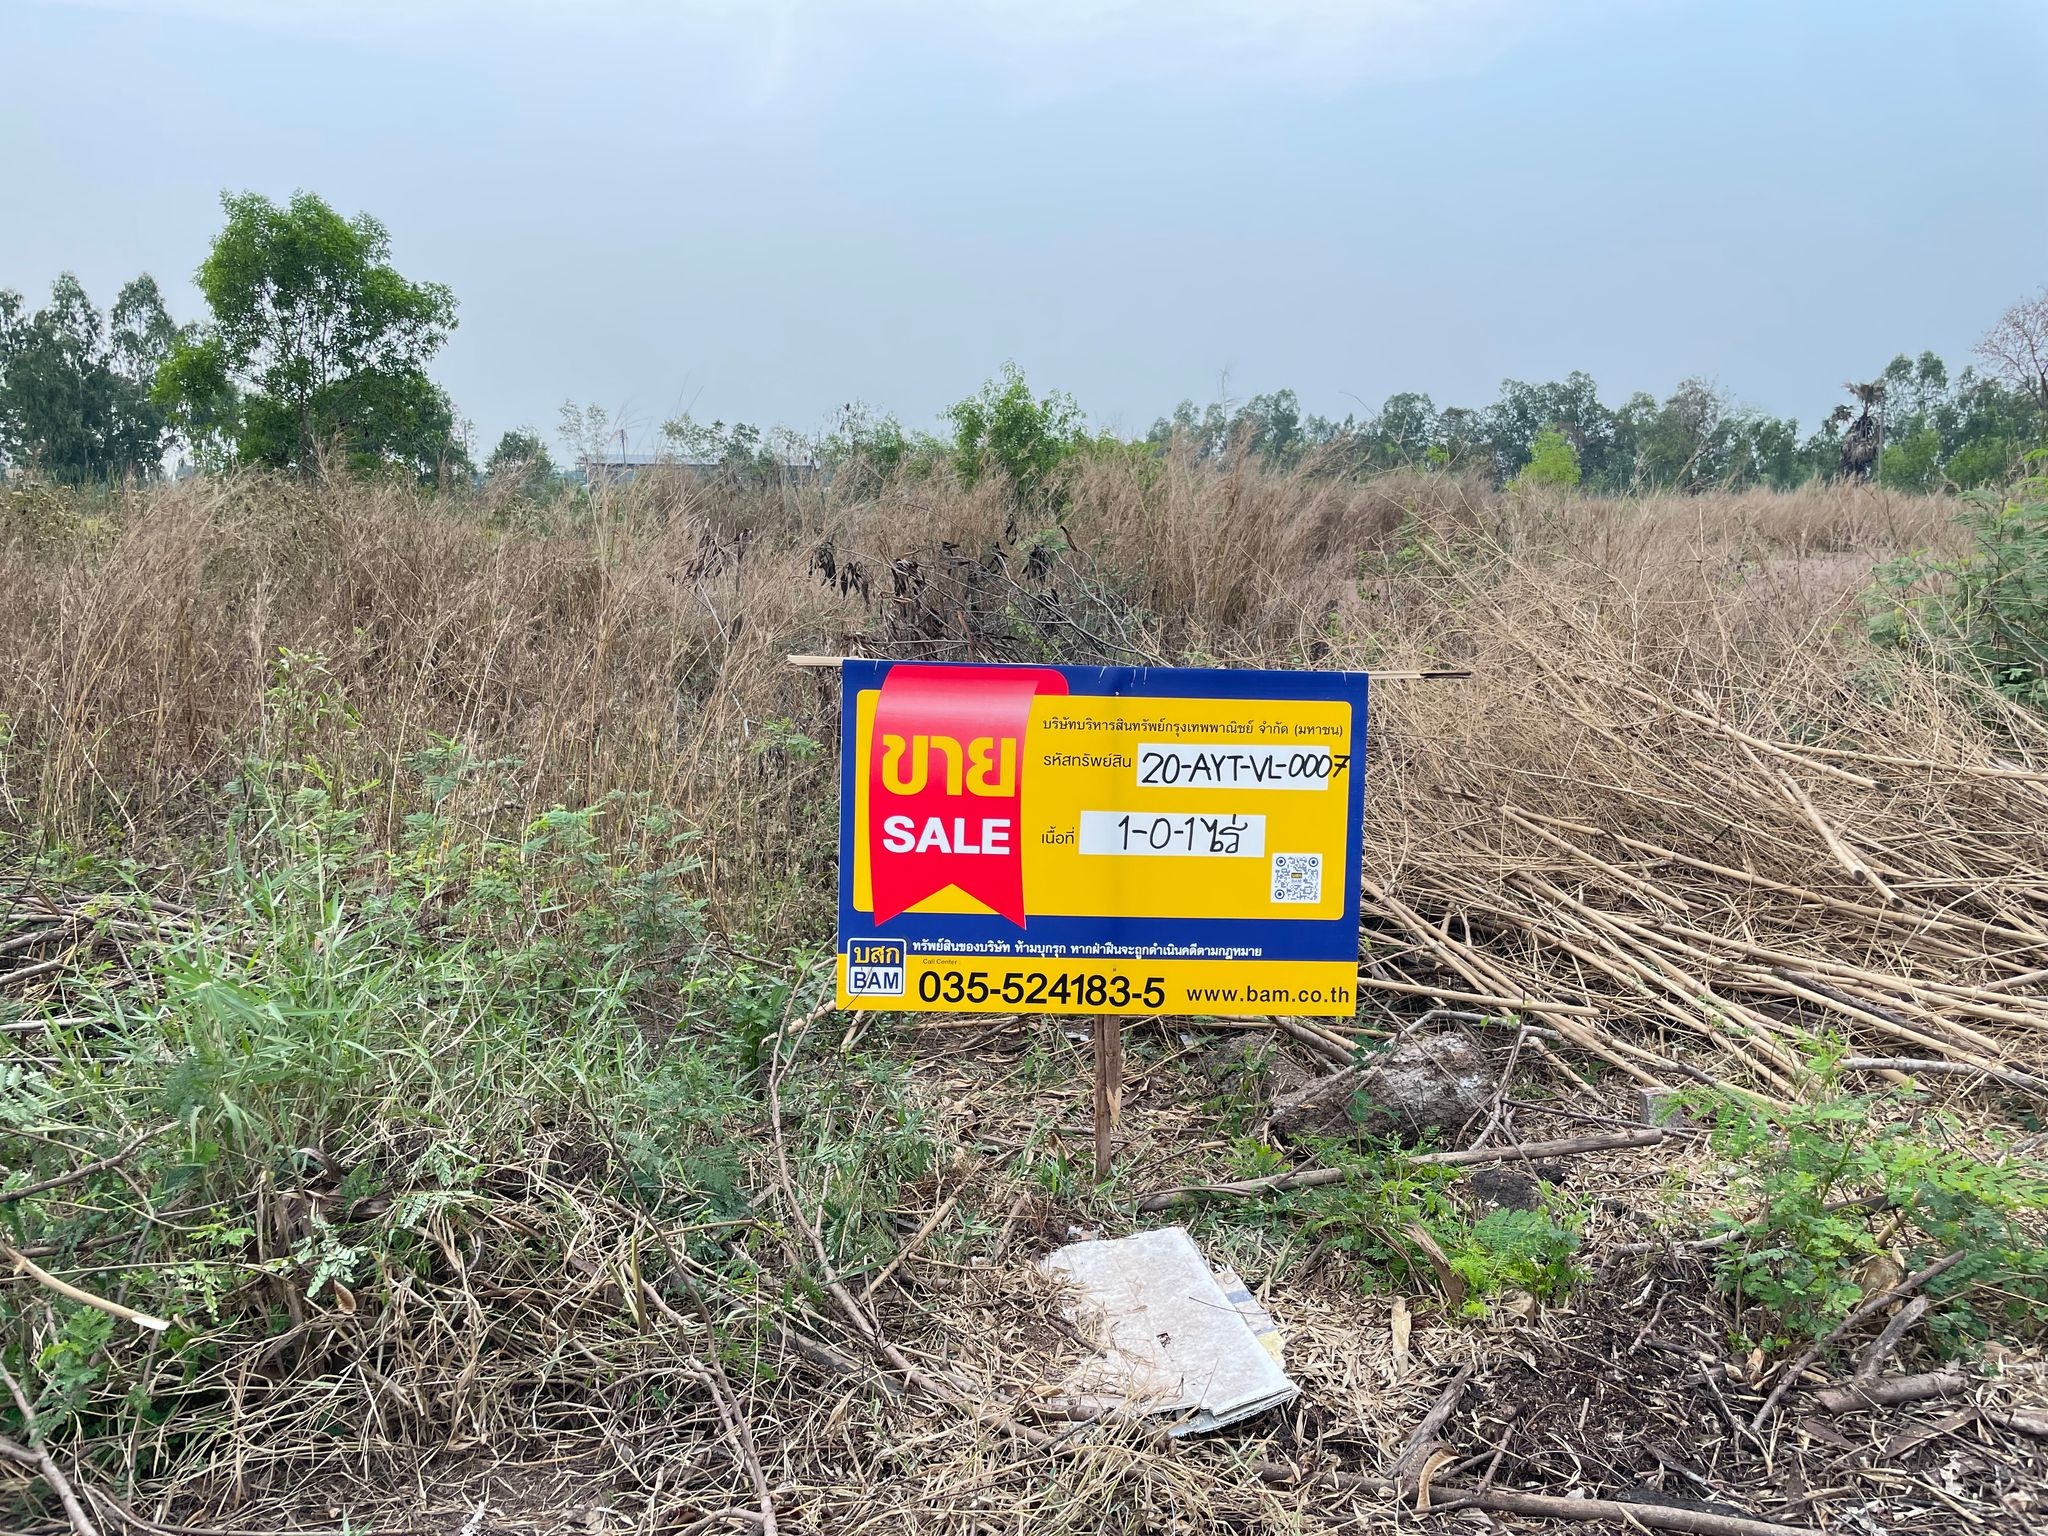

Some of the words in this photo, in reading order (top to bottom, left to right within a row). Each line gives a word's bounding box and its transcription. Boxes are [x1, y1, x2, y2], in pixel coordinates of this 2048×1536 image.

[1042, 717, 1253, 738] บริษัทบริหารสินทรัพย์กรุงเทพพาณิชย์
[1258, 721, 1289, 736] จำกัด
[1294, 724, 1344, 737] (มหาชน)
[881, 734, 1017, 798] ขาย
[1043, 752, 1132, 768] รหัสทรัพย์สิน
[1140, 752, 1351, 784] 20-AYT-VL-0007
[882, 815, 1011, 856] SALE
[1040, 825, 1075, 846] เนื้อที่
[853, 945, 900, 965] บสก
[912, 938, 1011, 953] ทรัพย์สินของบริษัท
[1014, 940, 1067, 958] ห้ามบุกรุก
[1070, 942, 1262, 960] หากฝ่าฝืนจะถูกดำเนินคดีตามกฎหมาย
[854, 971, 899, 989] BAM
[918, 971, 1166, 1008] 035-524183-5
[1186, 983, 1350, 1005] www.bam.co.th
